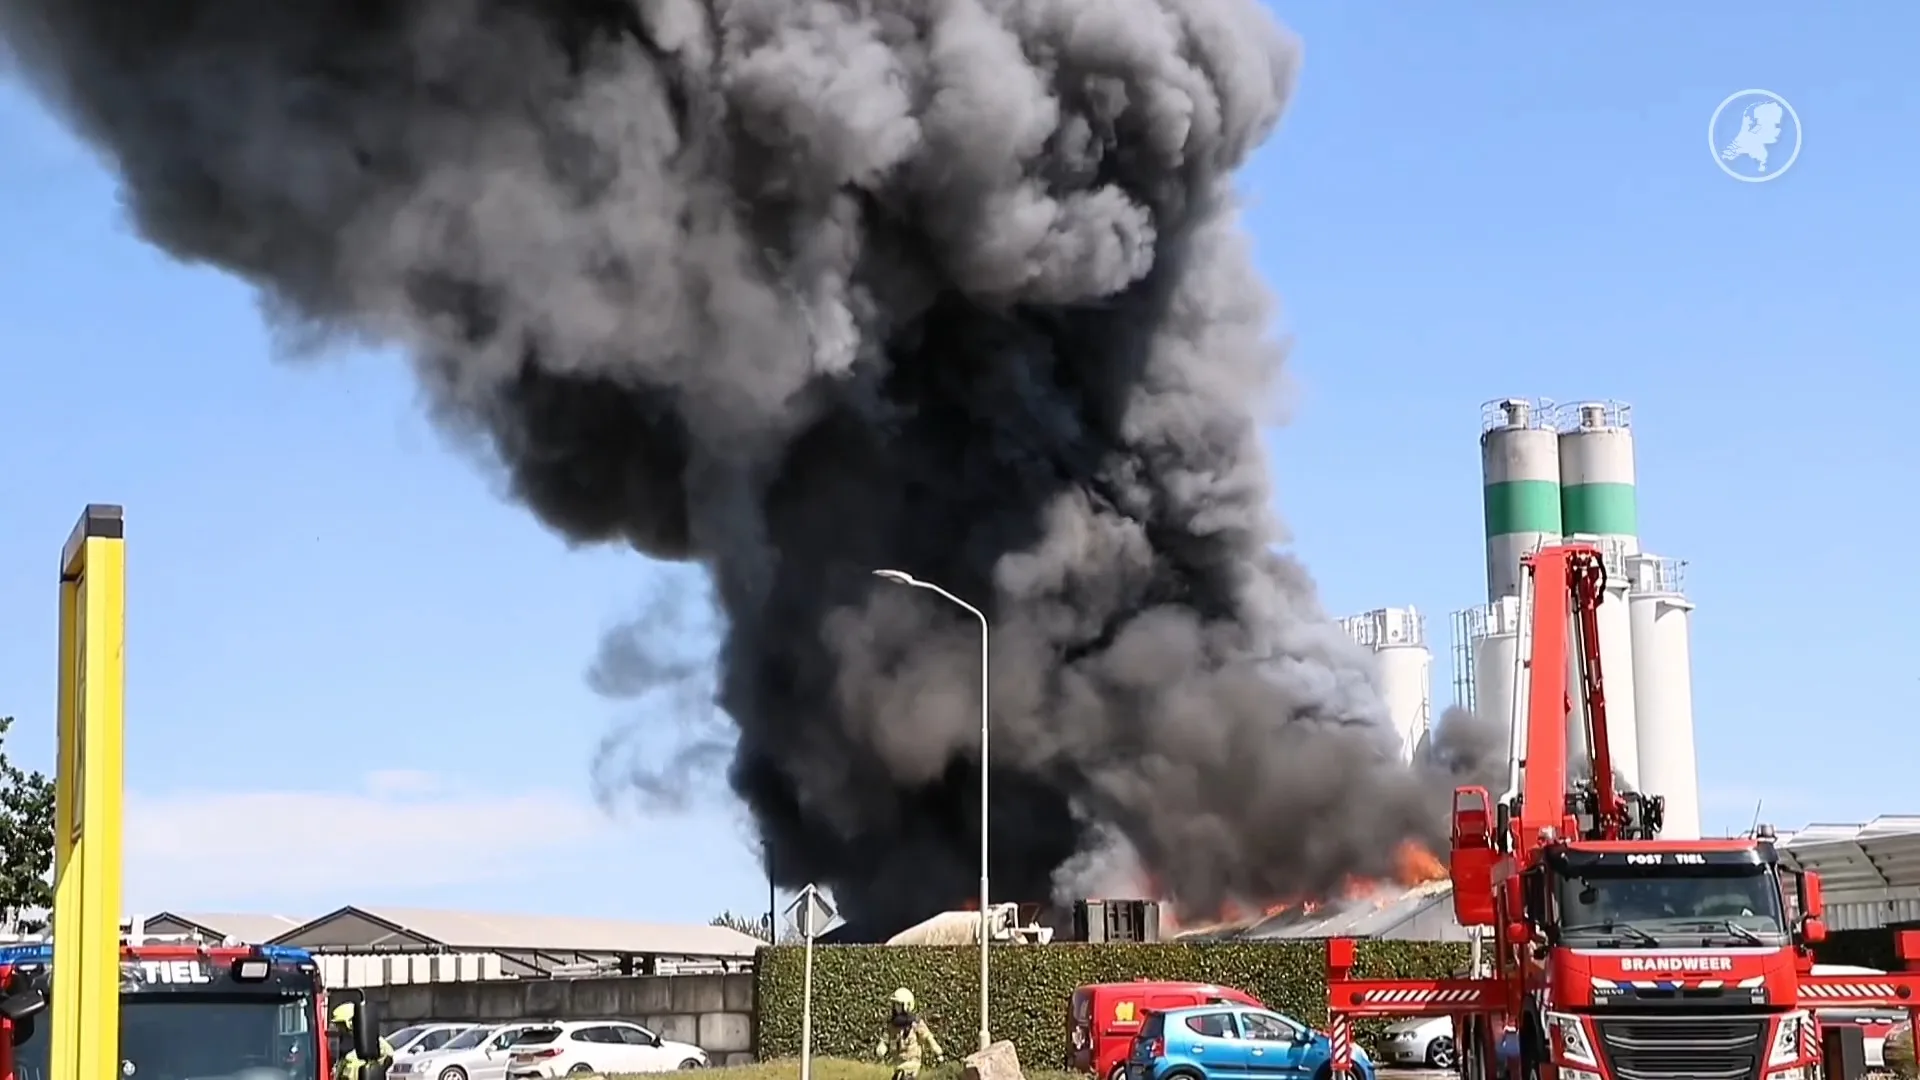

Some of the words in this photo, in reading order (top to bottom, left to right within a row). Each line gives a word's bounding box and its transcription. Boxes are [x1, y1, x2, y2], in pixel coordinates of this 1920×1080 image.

[1627, 853, 1662, 865] POST
[1675, 853, 1706, 865] TIEL
[1621, 957, 1732, 970] BRANDWEER
[140, 960, 210, 984] TIEL
